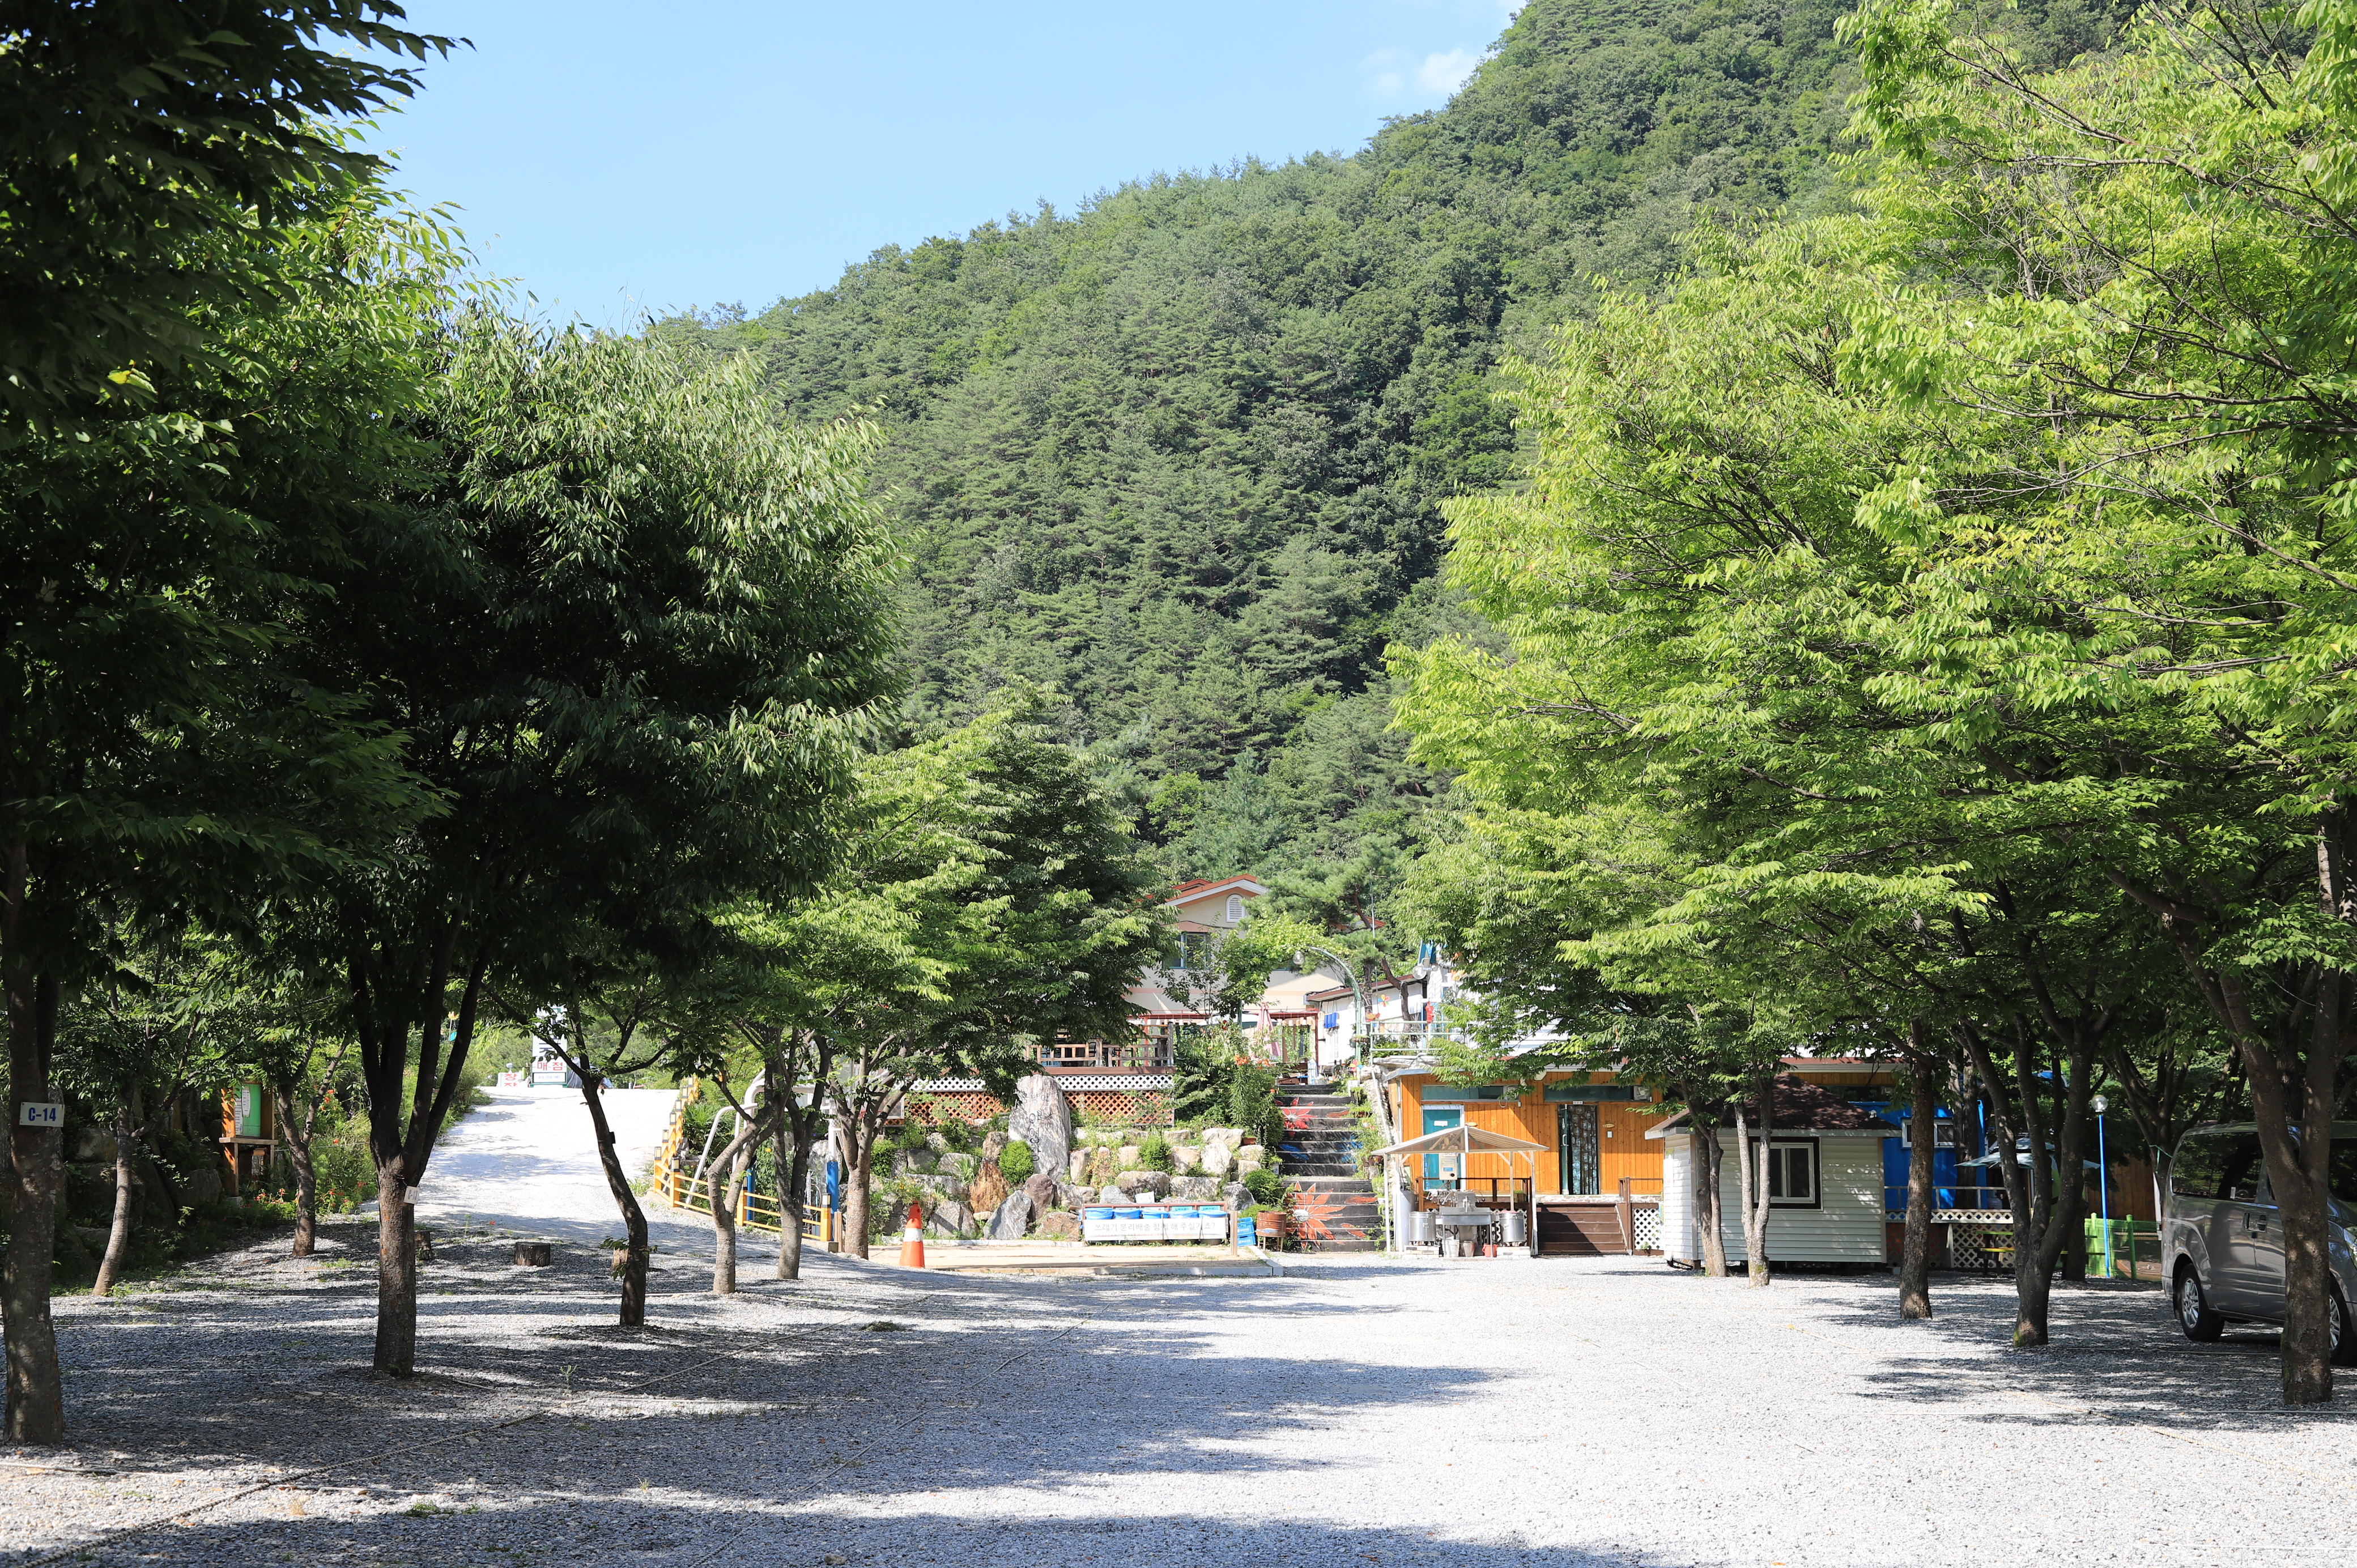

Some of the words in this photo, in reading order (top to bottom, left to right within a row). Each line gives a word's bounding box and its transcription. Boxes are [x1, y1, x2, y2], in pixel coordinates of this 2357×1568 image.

[537, 1062, 563, 1071] 매점
[28, 1107, 56, 1121] C-14
[1095, 1223, 1117, 1232] 쓰레기
[1120, 1223, 1151, 1232] 분리배출
